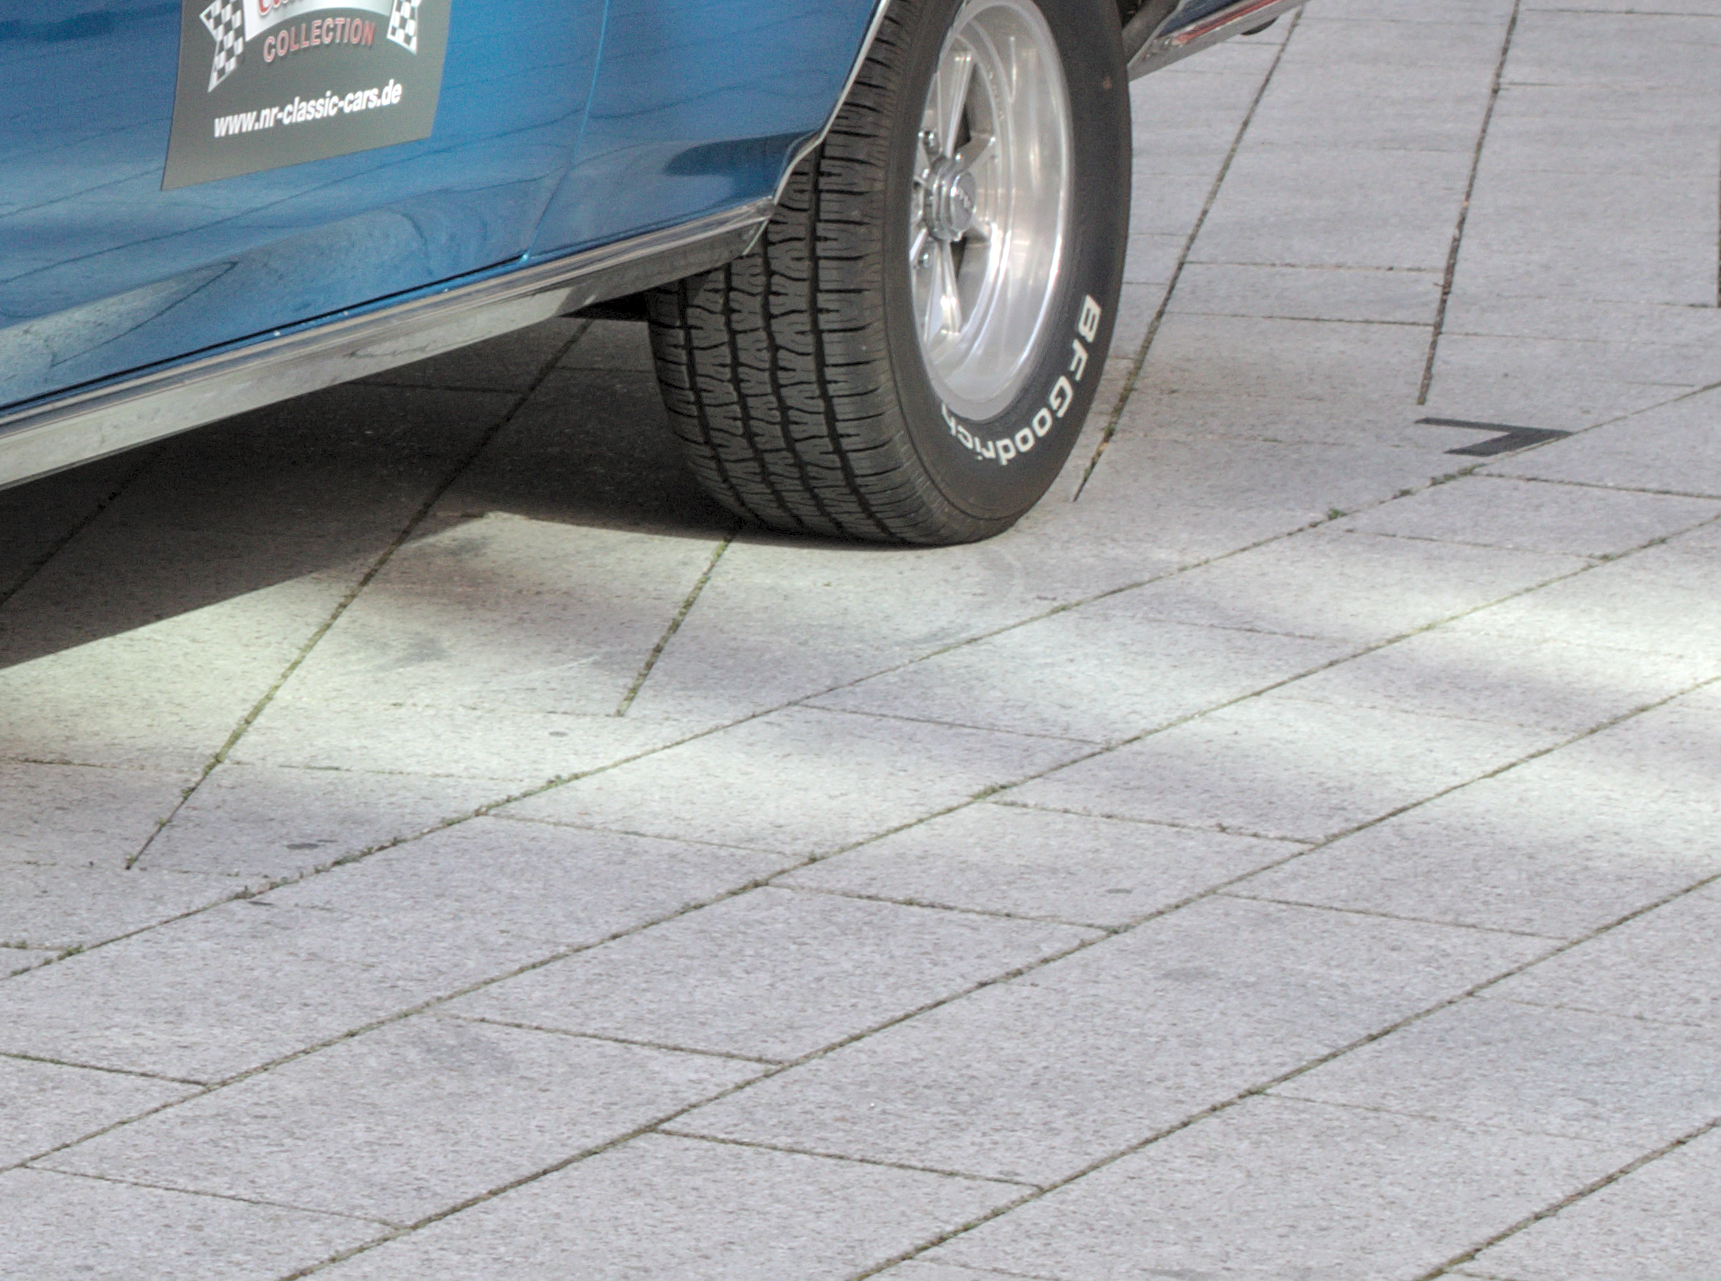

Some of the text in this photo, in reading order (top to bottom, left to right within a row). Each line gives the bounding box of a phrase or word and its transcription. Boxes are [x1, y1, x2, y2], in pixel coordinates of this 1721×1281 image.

[263, 18, 376, 64] COLLECTION
[214, 78, 403, 138] www.nr-classic-cars.de
[942, 294, 1101, 466] BFGoodrich
